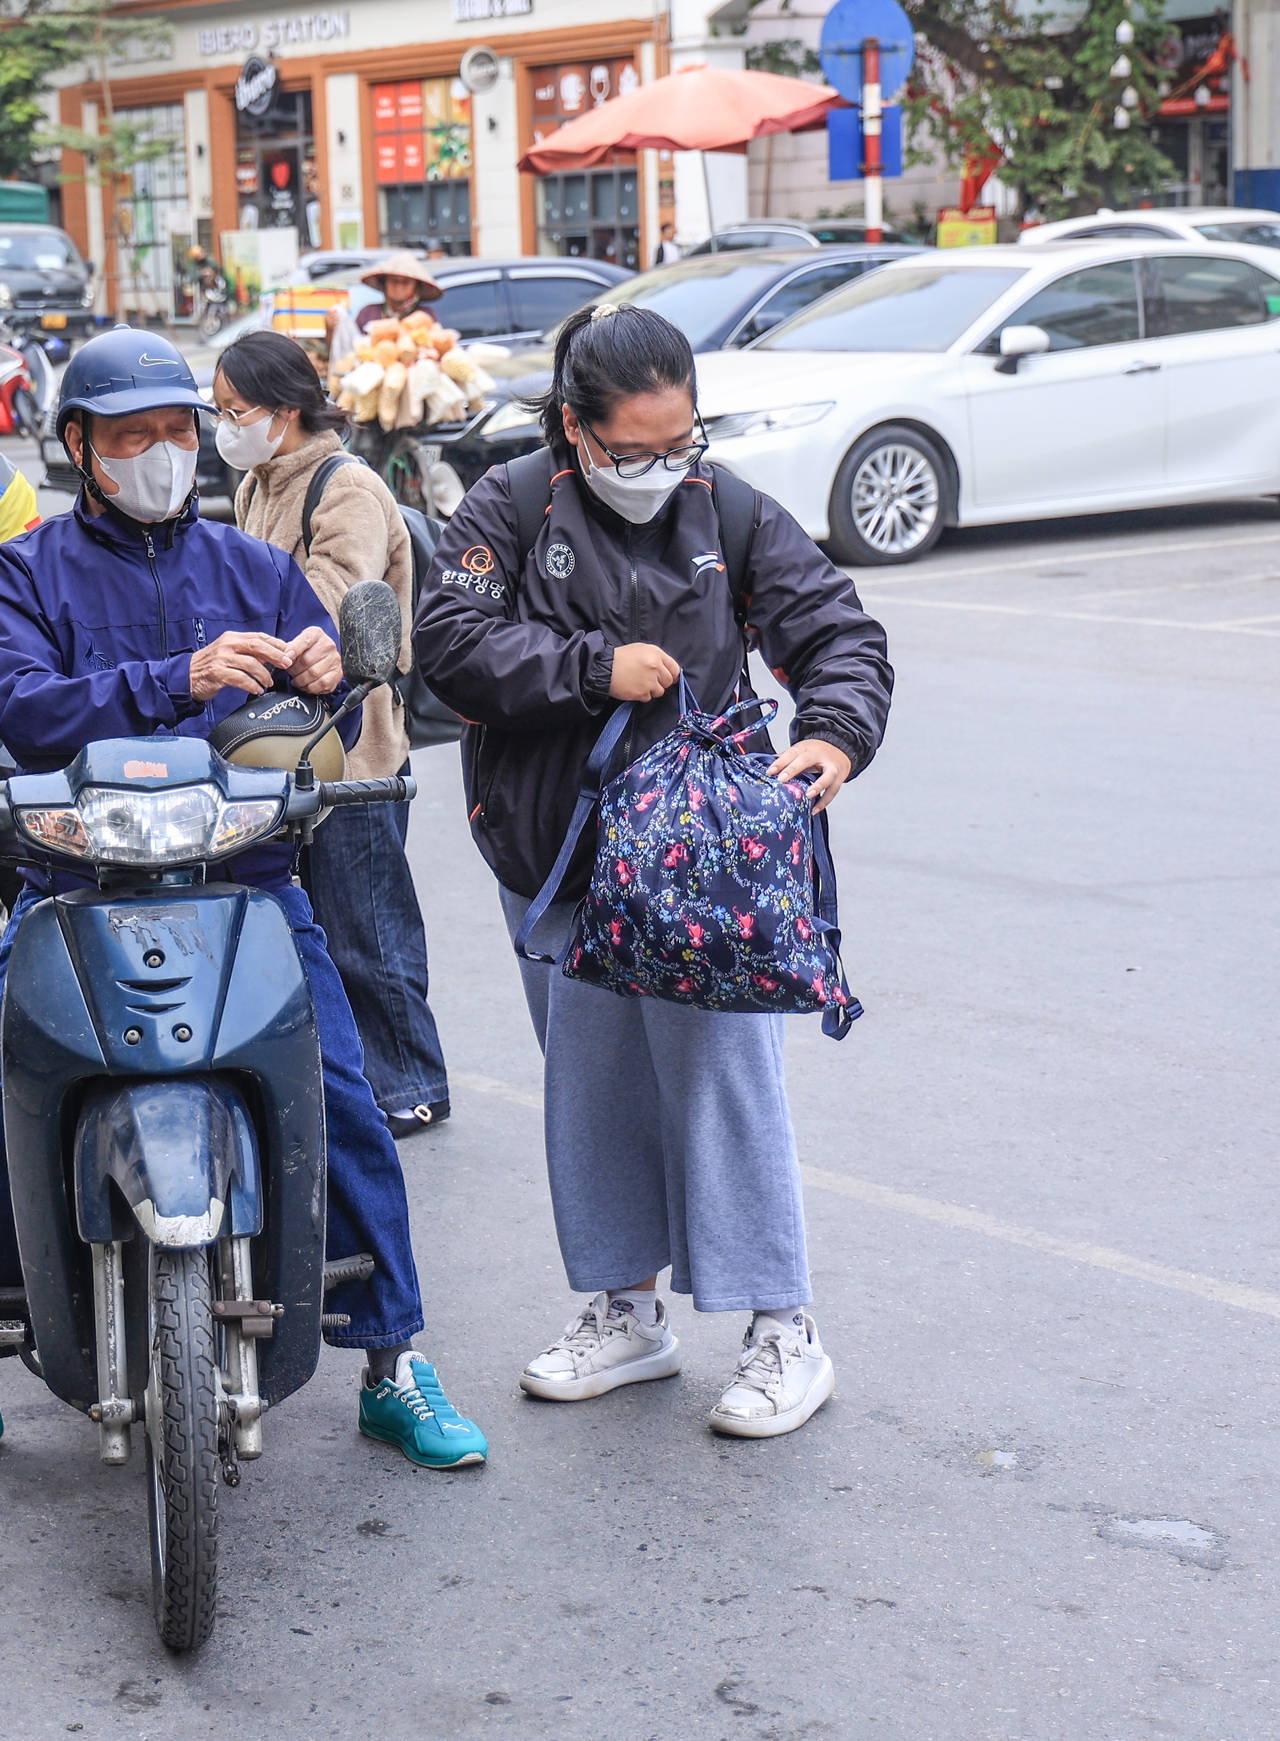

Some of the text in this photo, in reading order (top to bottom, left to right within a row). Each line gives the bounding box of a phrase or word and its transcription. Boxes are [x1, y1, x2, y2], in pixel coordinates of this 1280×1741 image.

[263, 11, 349, 47] STATION
[441, 570, 506, 599] 한화생명
[257, 695, 310, 720] Vespa
